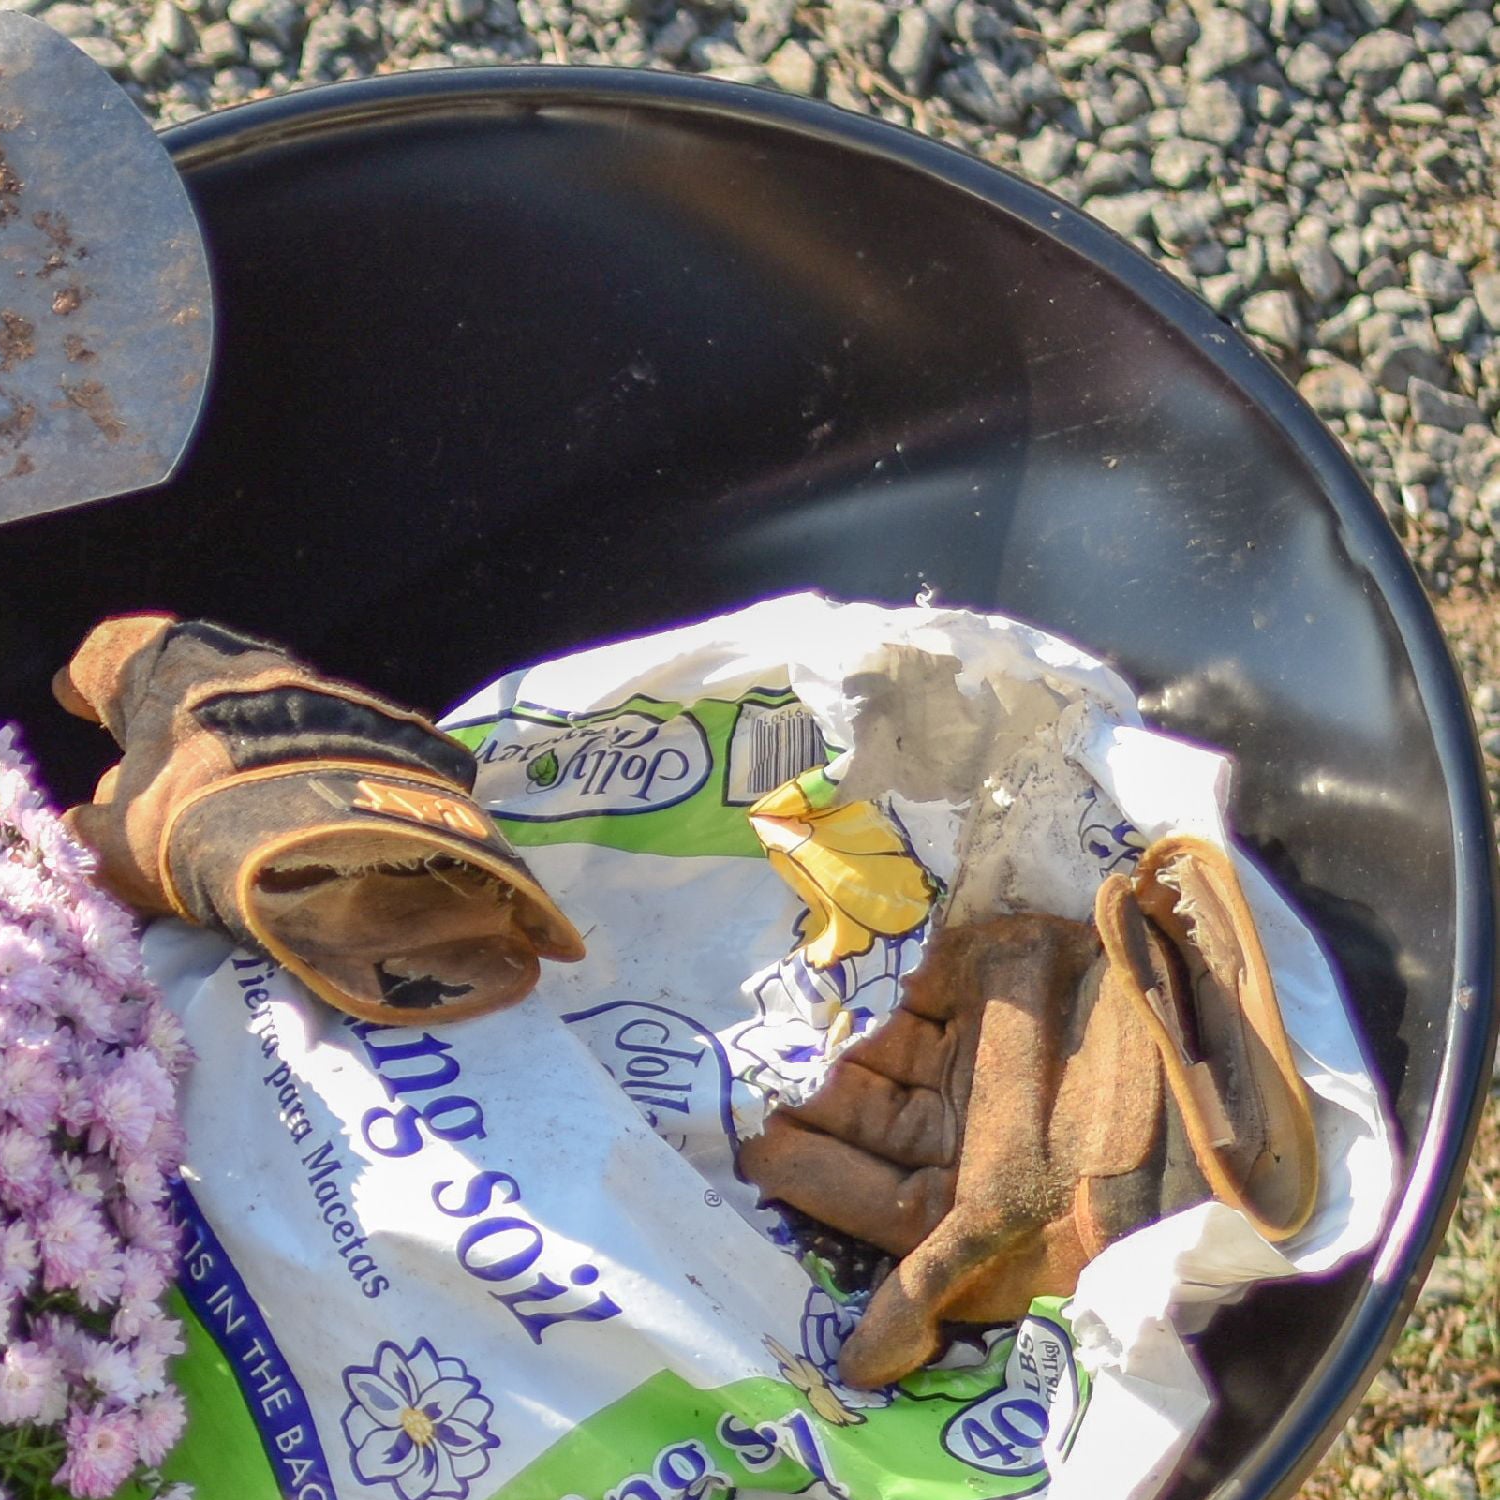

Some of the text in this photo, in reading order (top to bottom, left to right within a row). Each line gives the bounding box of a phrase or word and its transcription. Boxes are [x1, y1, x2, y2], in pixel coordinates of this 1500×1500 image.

[545, 736, 690, 800] Jolly
[614, 1018, 706, 1128] Joll
[263, 1063, 314, 1146] para
[301, 1139, 390, 1299] Macetas
[431, 1169, 624, 1346] soil
[183, 1240, 214, 1281] IS
[205, 1284, 247, 1336] IN
[238, 1337, 294, 1419] THE
[961, 1329, 1050, 1466] 40 LBS
